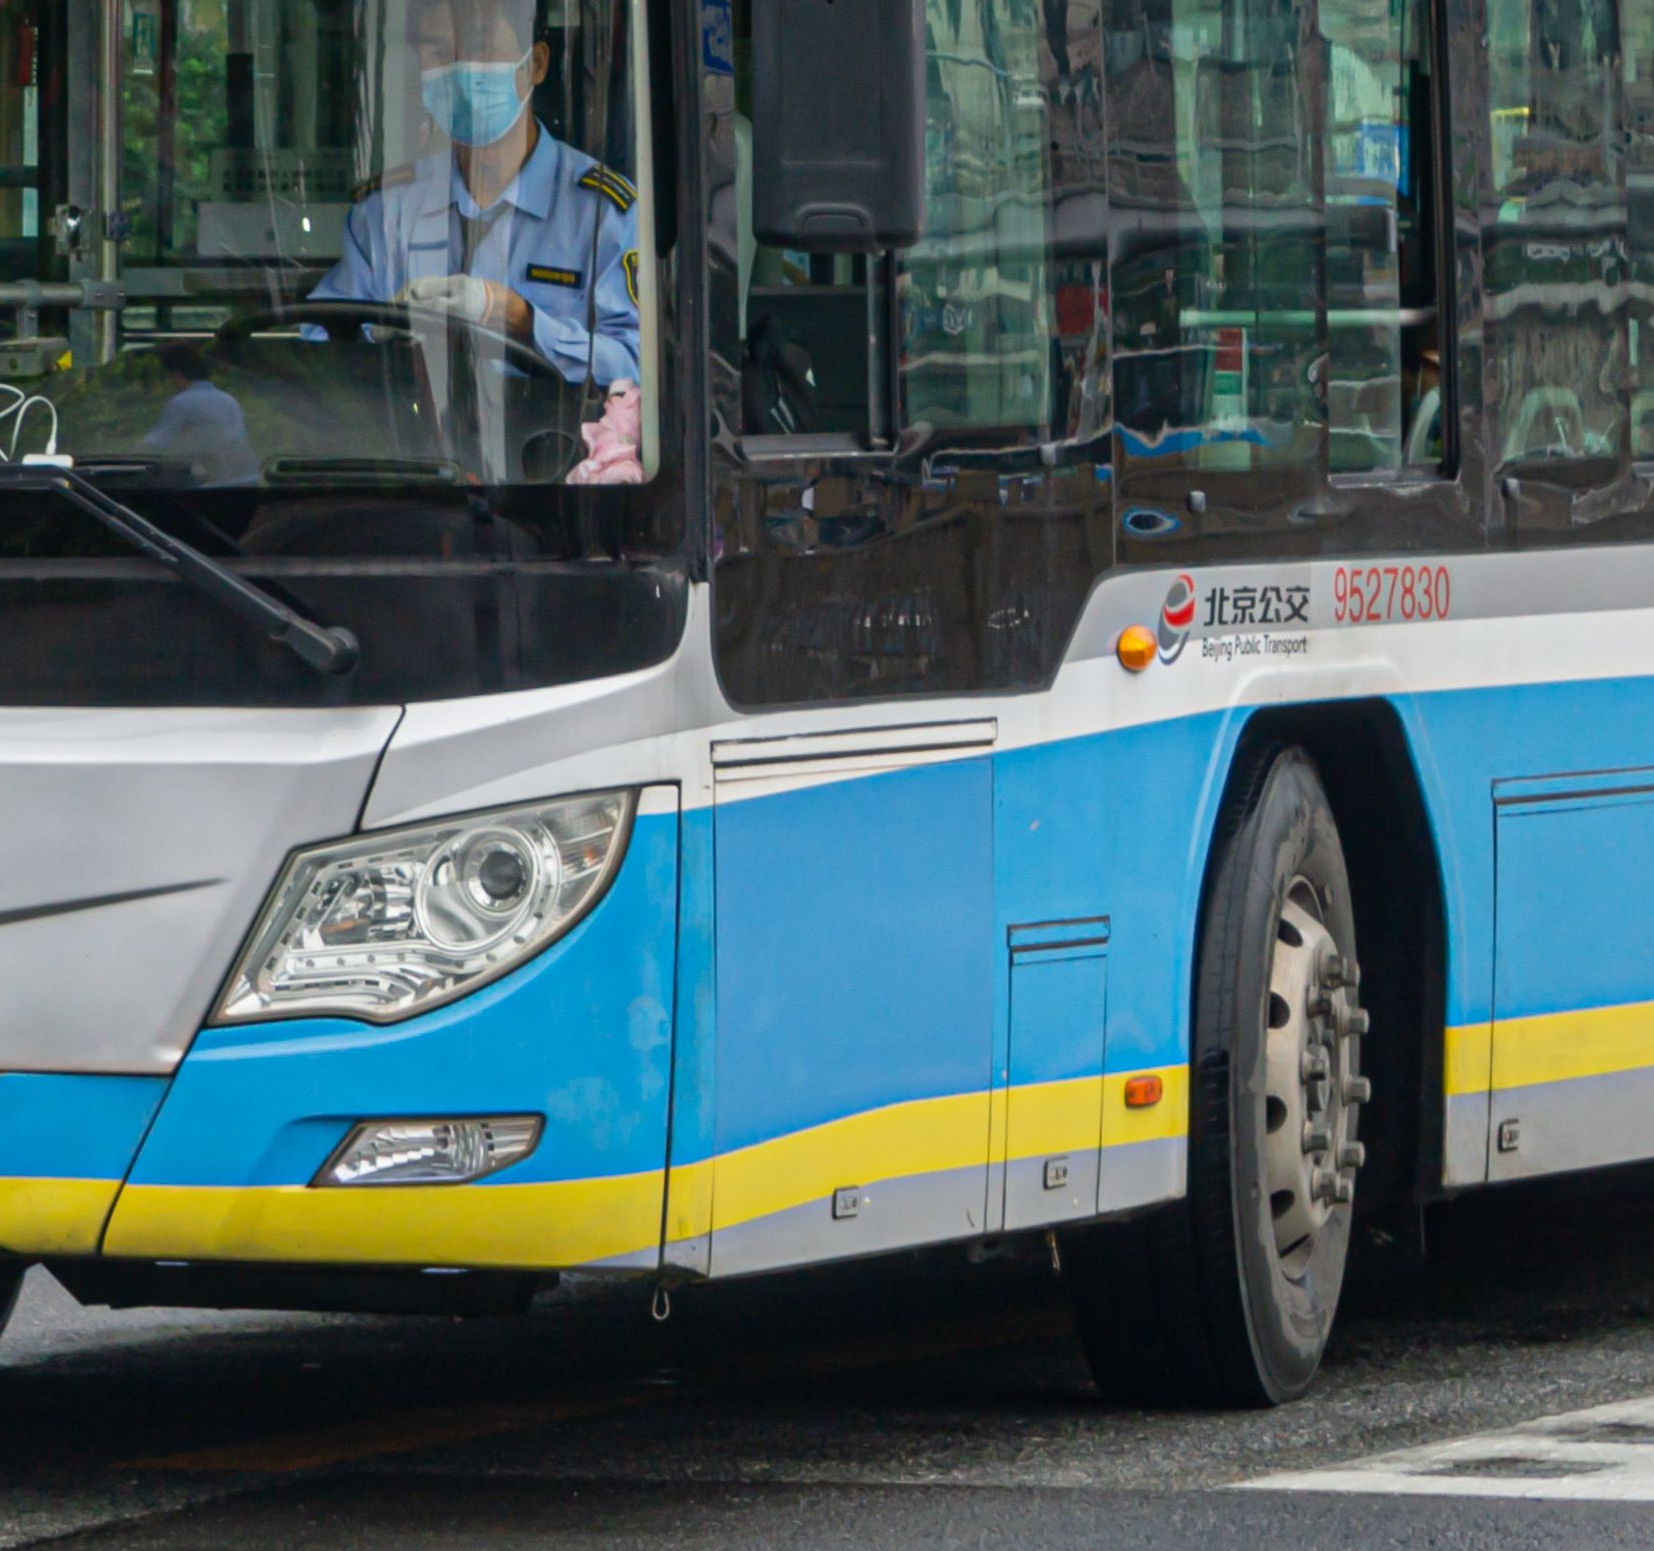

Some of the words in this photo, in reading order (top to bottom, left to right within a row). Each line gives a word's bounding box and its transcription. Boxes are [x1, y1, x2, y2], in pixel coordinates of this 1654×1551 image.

[1203, 586, 1310, 627] 北京公交
[1334, 565, 1451, 623] 9527830
[1202, 636, 1233, 662] Beijing
[1234, 634, 1261, 655] Public
[1263, 633, 1307, 658] Transport
